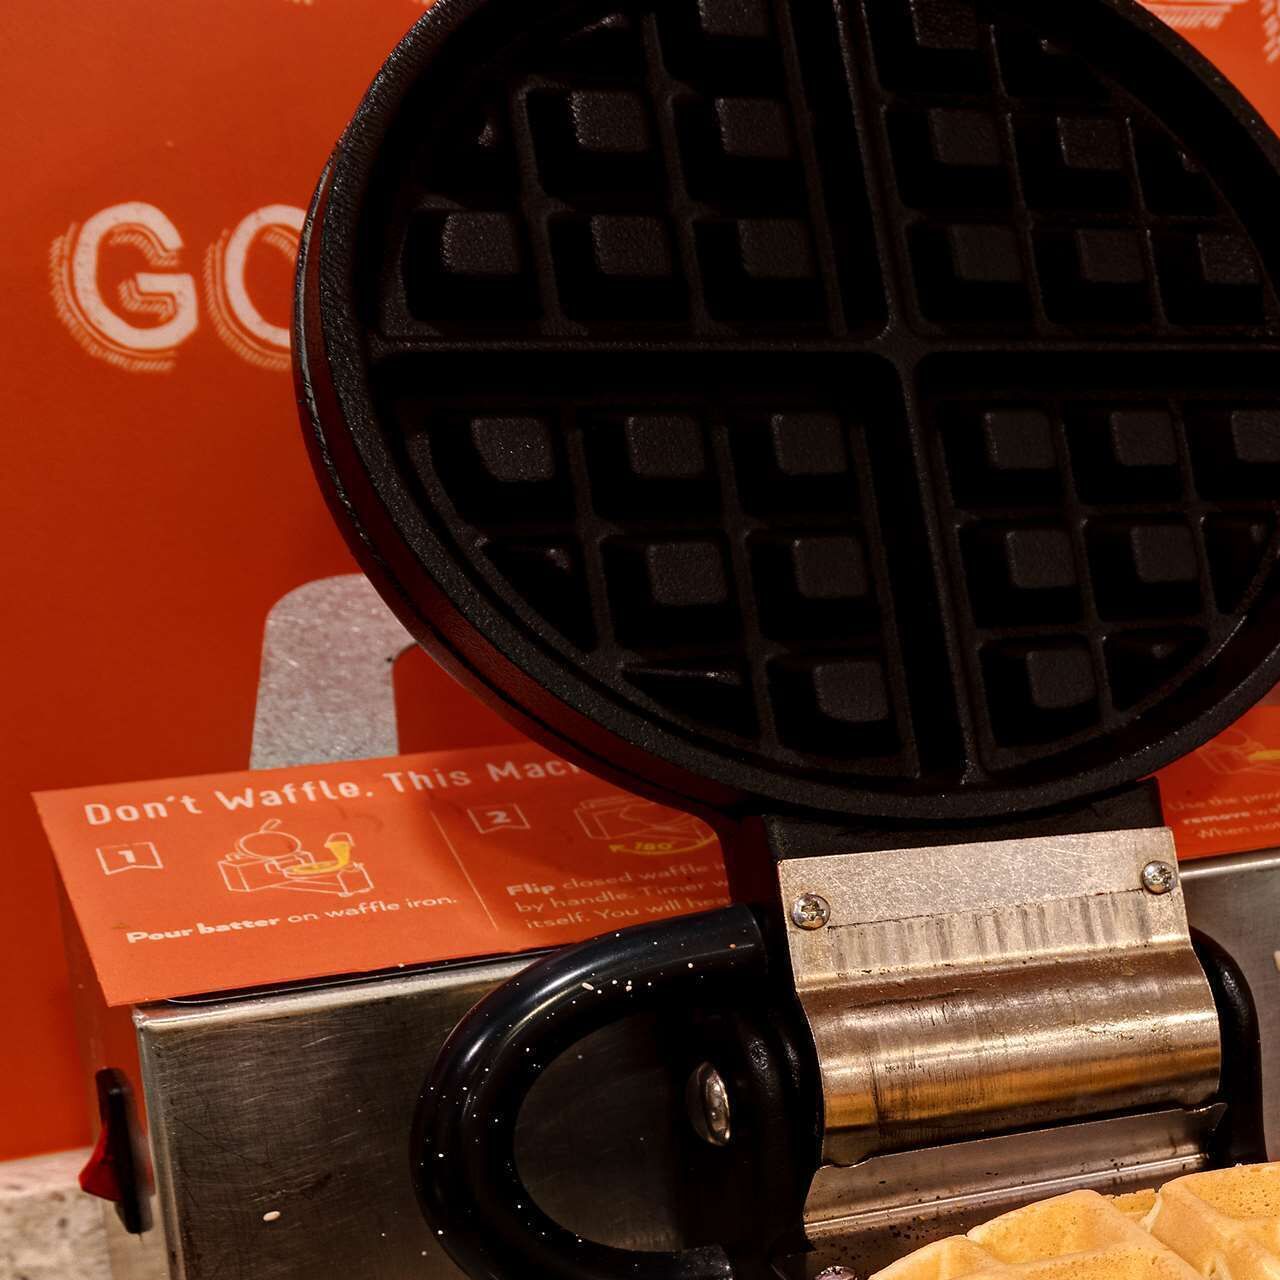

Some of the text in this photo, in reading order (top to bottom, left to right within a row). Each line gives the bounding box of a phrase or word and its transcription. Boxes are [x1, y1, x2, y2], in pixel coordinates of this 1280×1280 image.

[84, 795, 202, 826] Don't
[214, 779, 374, 812] Waffle.
[384, 768, 472, 793] This
[506, 882, 556, 898] Flip
[562, 872, 633, 890] closed
[639, 863, 708, 881] waffle
[515, 901, 544, 914] by
[551, 890, 636, 909] handle.
[641, 882, 706, 896] Timer
[126, 894, 458, 944] Pour batter on waffle iron.
[525, 915, 591, 930] itself.
[595, 908, 640, 921] You
[646, 899, 683, 913] will
